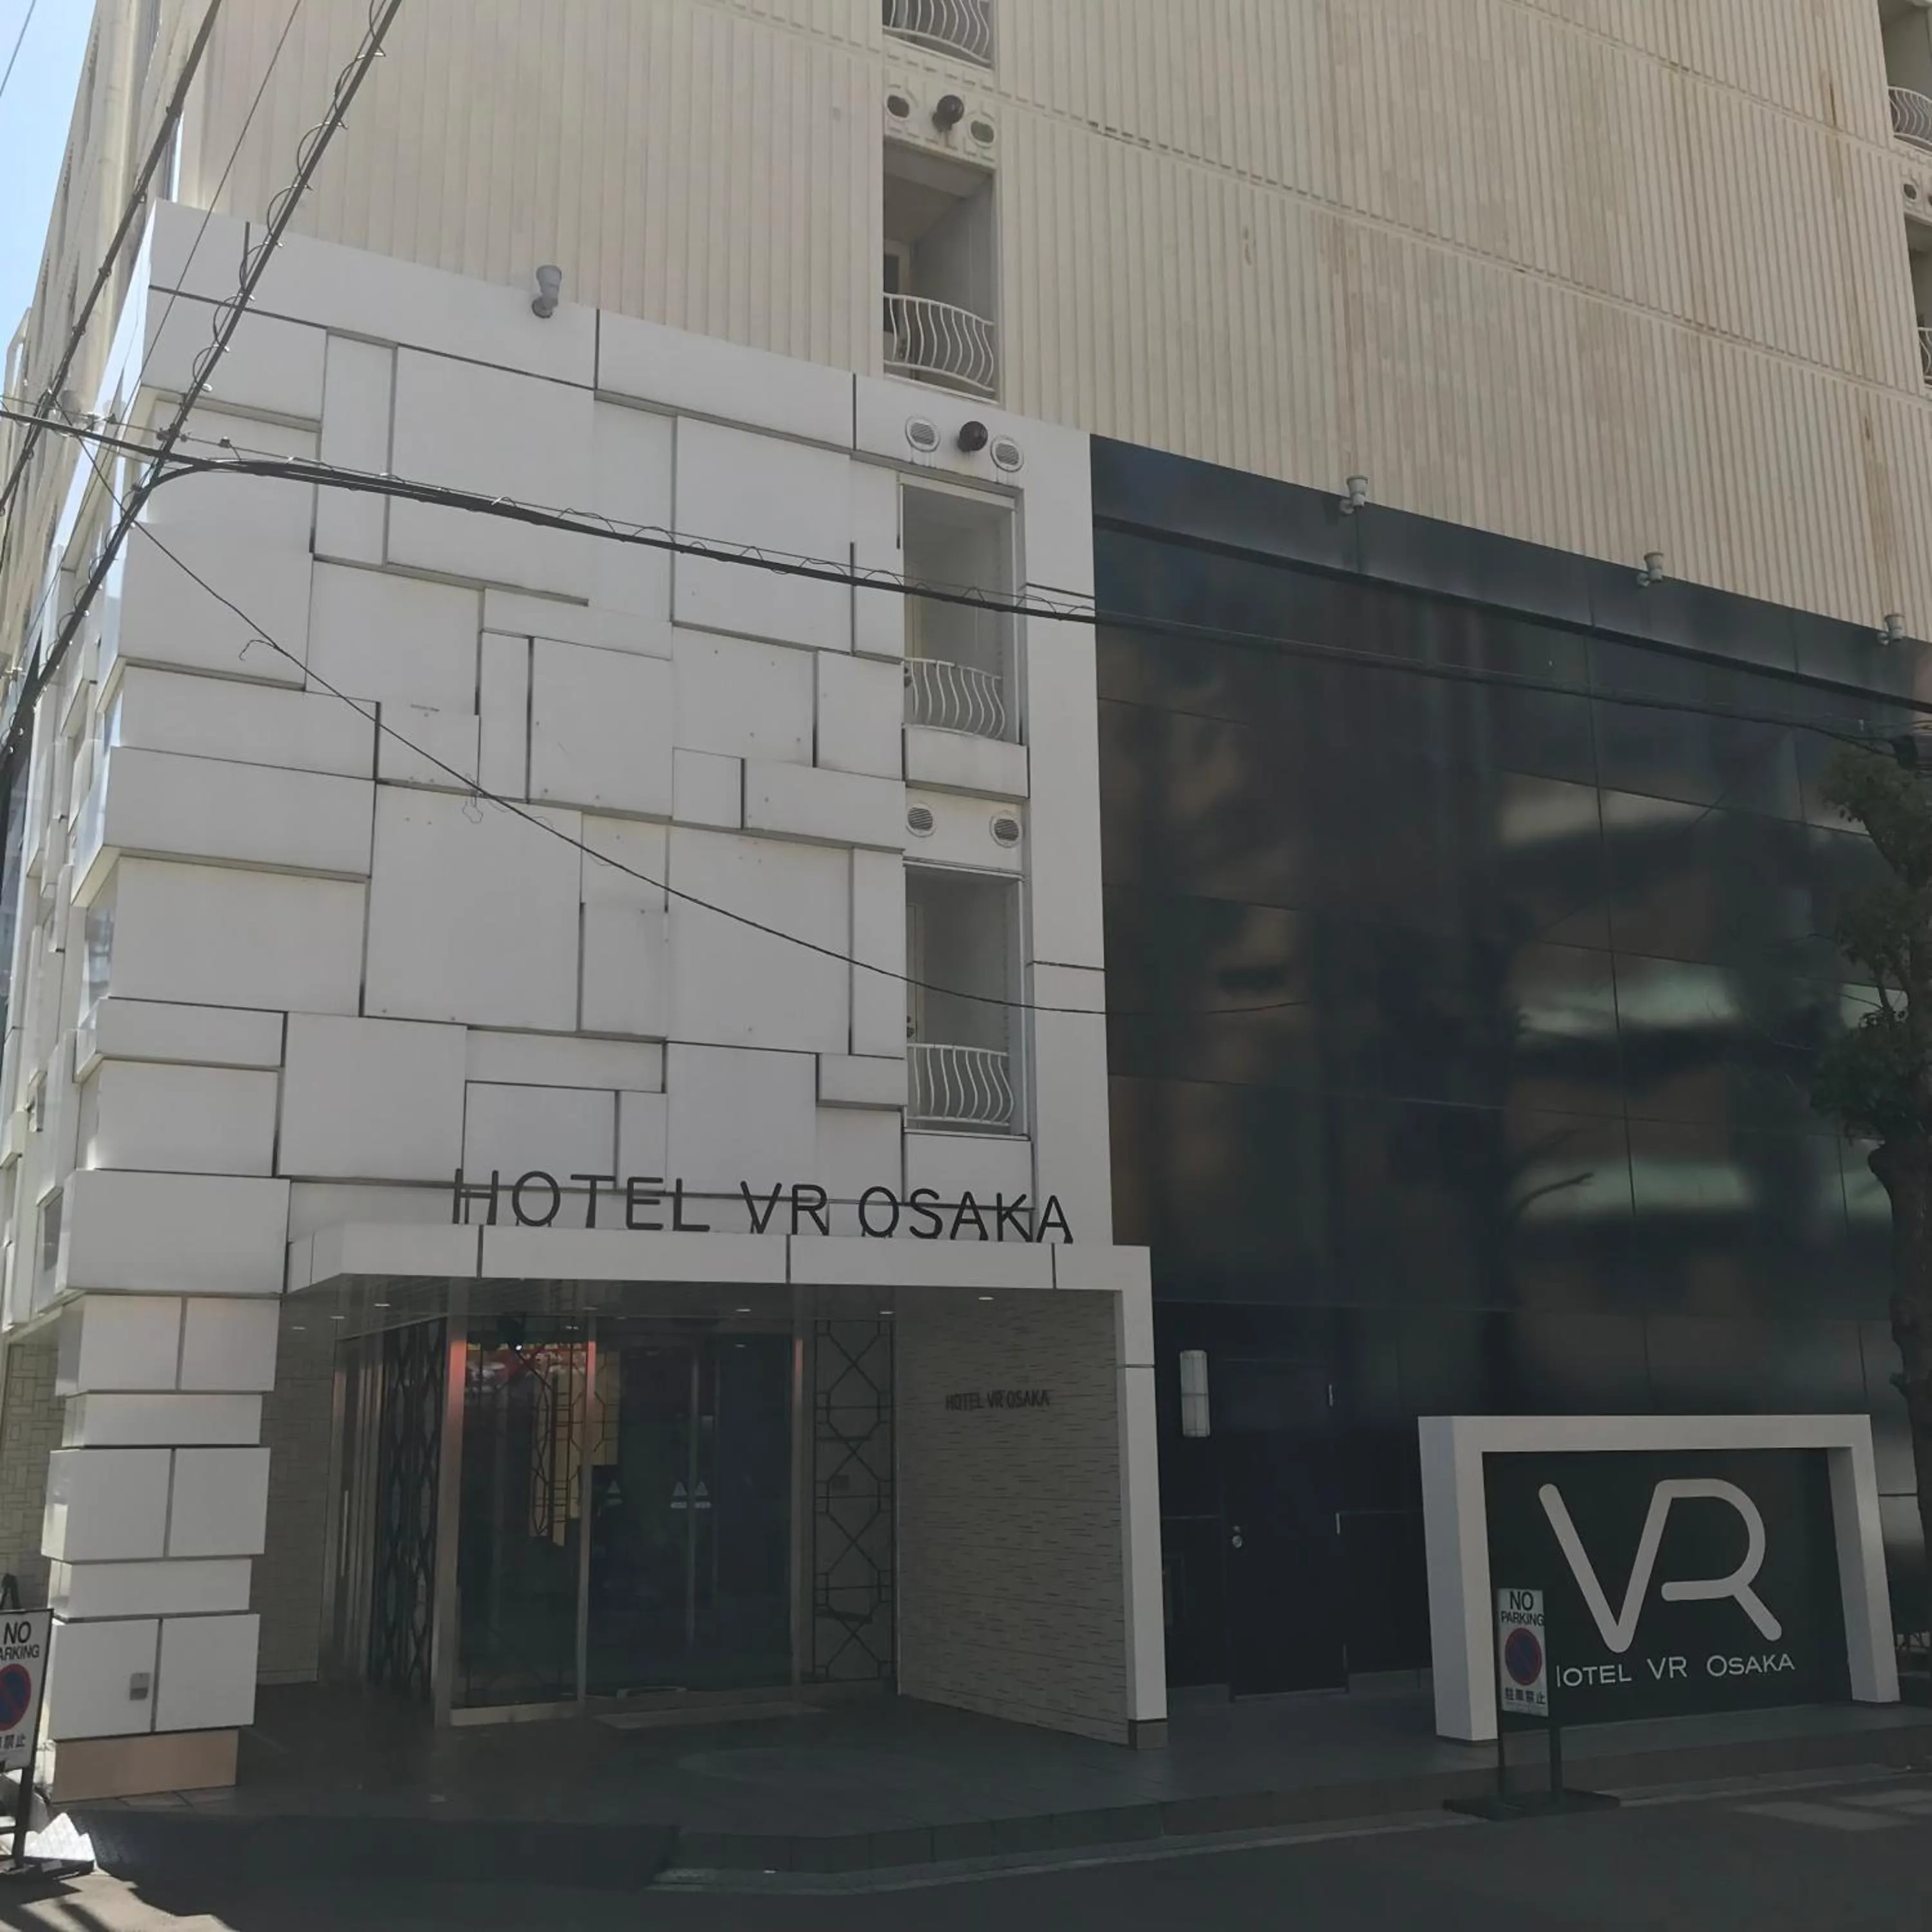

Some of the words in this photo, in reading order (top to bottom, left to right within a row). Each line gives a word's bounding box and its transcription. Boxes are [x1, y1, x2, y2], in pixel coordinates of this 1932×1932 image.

[453, 1168, 710, 1232] HOTEL
[741, 1180, 829, 1236] VR
[858, 1186, 1074, 1244] OSAKA
[945, 1392, 985, 1410] HOTEL
[1006, 1389, 1051, 1409] OSAKA
[1539, 1479, 1782, 1653] VR
[1510, 1591, 1534, 1611] NO
[1501, 1611, 1545, 1626] PARKING
[4, 1620, 32, 1644] NO
[0, 1643, 40, 1661] ARKING
[1647, 1656, 1688, 1680] VR
[1706, 1653, 1795, 1676] OSAKA
